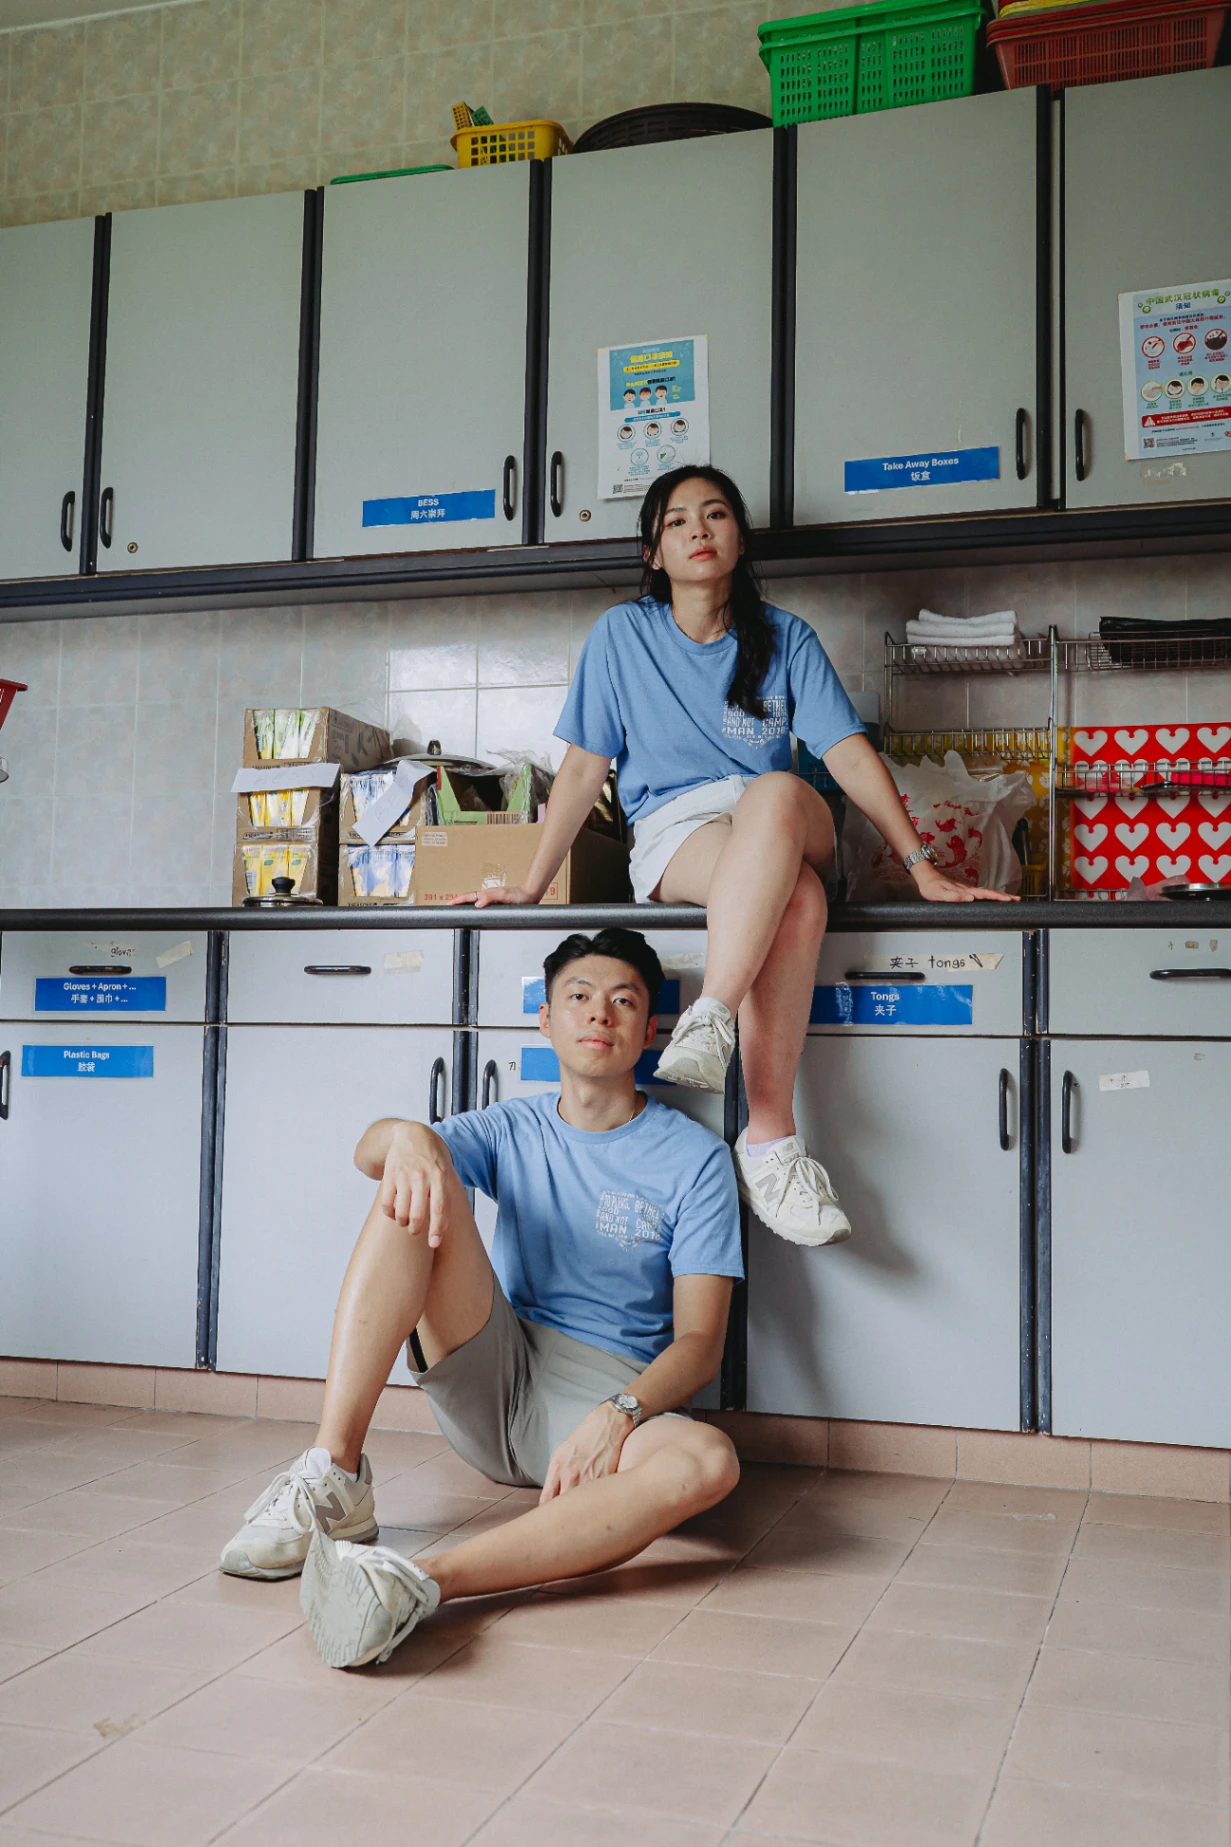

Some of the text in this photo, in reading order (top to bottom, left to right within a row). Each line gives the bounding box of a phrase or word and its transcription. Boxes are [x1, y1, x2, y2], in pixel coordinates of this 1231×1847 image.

[1145, 288, 1219, 305] 中国武汉冠状病毒
[882, 458, 959, 471] Take Away Boxes
[910, 471, 931, 481] 饭盒
[417, 498, 439, 507] BESS
[410, 508, 446, 520] 周六崇拜
[727, 727, 755, 735] MAN
[928, 955, 965, 969] tongs
[63, 982, 91, 990] Gloves
[98, 982, 122, 992] Apron
[71, 993, 88, 1004] 手套
[870, 992, 900, 1002] Tongs
[874, 1005, 897, 1016] 夹子
[63, 1050, 110, 1060] Plastic Bags
[600, 1222, 627, 1235] MAN
